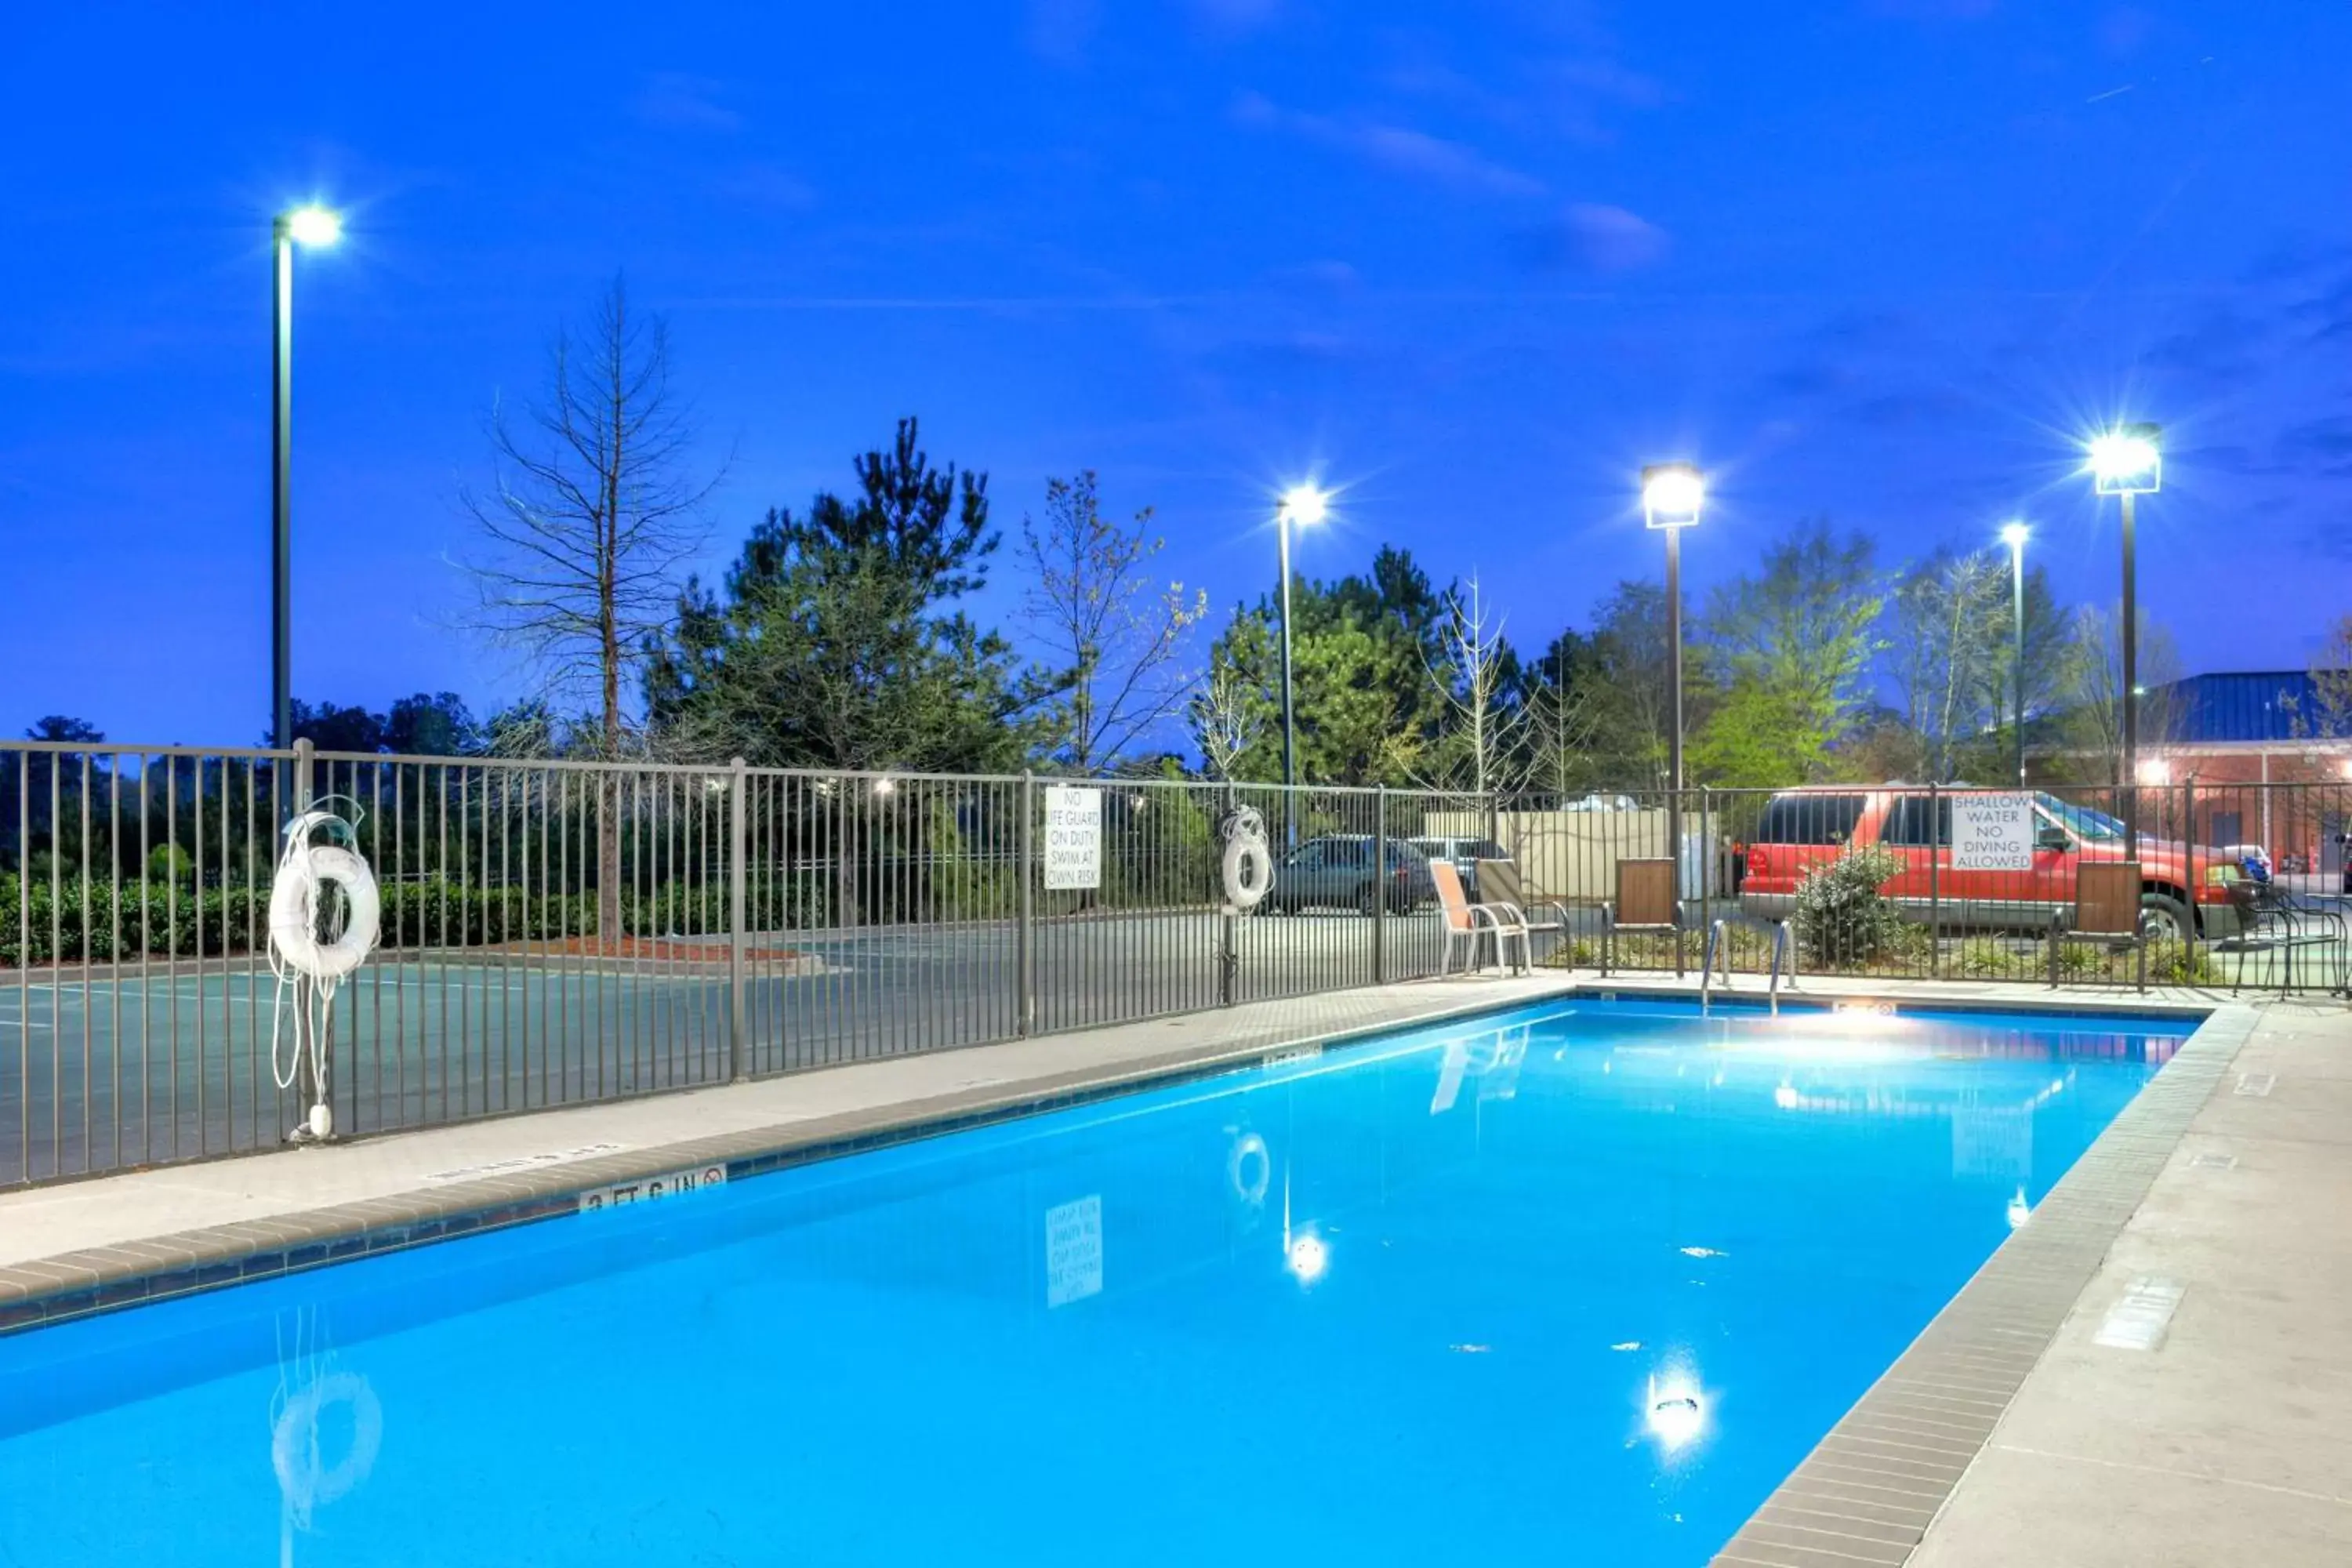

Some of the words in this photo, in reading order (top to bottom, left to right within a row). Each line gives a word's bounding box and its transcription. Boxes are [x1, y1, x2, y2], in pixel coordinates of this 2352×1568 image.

[1064, 791, 1081, 806] NO
[1955, 796, 2031, 808] SHALLOW
[1065, 811, 1099, 826] GUARD
[1966, 811, 2019, 822] WATER
[1051, 830, 1067, 845] ON
[1070, 830, 1094, 846] DUTY
[1976, 826, 2003, 837] NO
[1963, 840, 2020, 852] DIVING
[1051, 850, 1079, 865] SWIM
[1082, 850, 1094, 865] AT
[1956, 855, 2030, 868] ALLOWED
[1047, 870, 1075, 885] OWN
[1078, 869, 1097, 884] RISK
[614, 1185, 639, 1207] FT
[675, 1173, 695, 1193] IN
